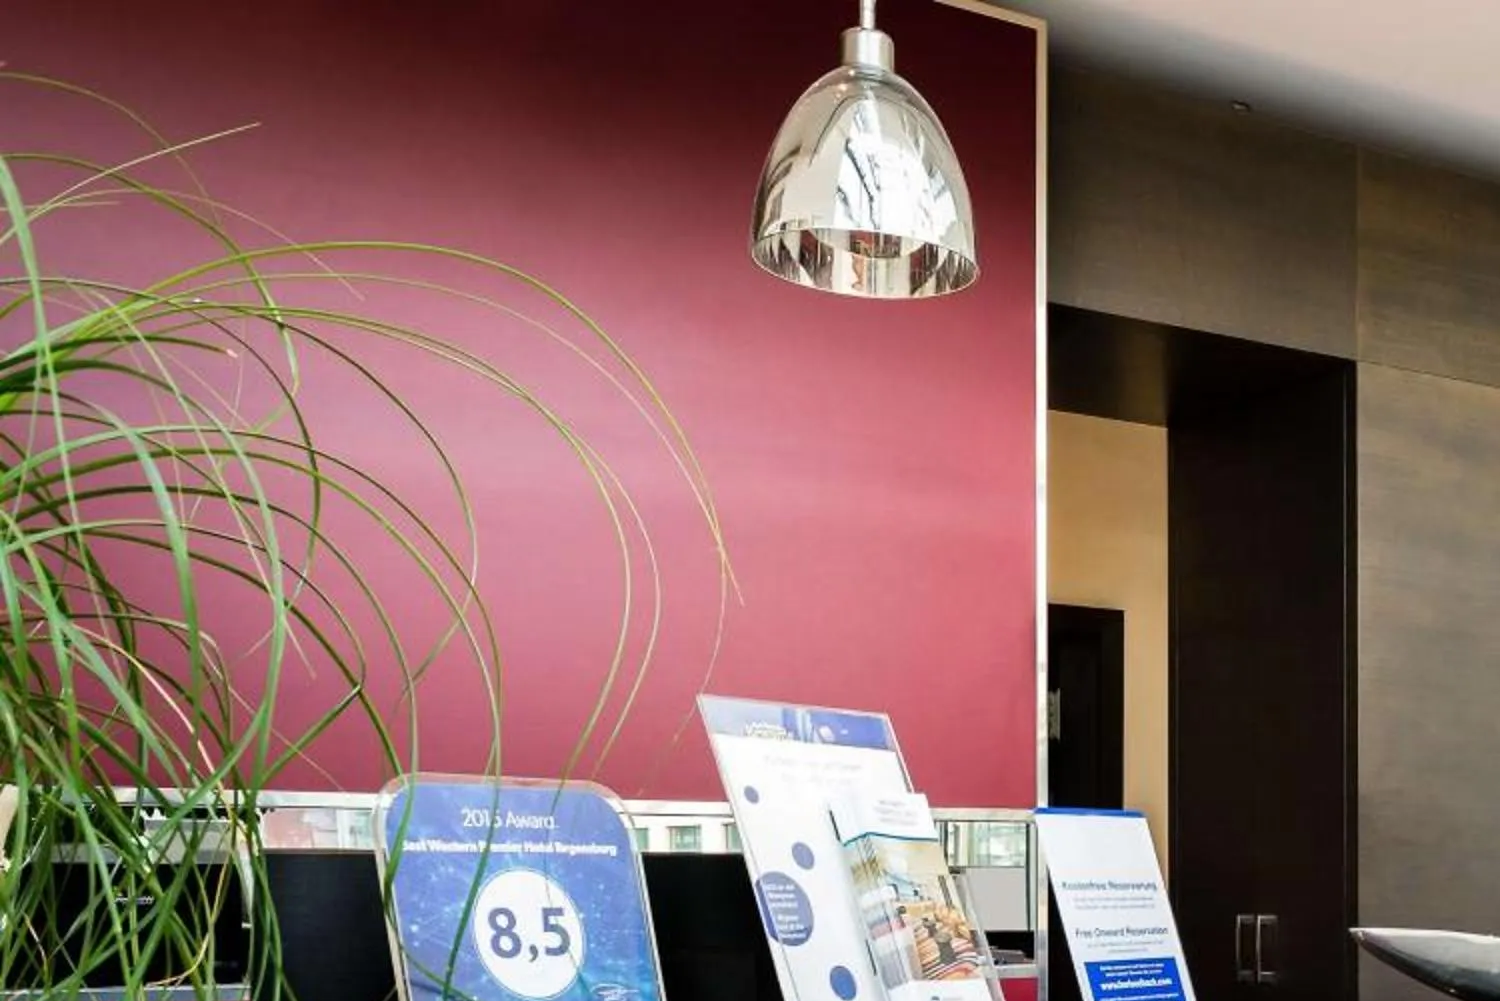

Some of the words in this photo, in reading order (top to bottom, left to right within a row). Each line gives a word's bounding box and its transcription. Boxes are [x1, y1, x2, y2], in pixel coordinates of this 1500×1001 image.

[479, 839, 522, 853] Pemier
[488, 907, 571, 963] 8,5
[1075, 927, 1092, 937] Free
